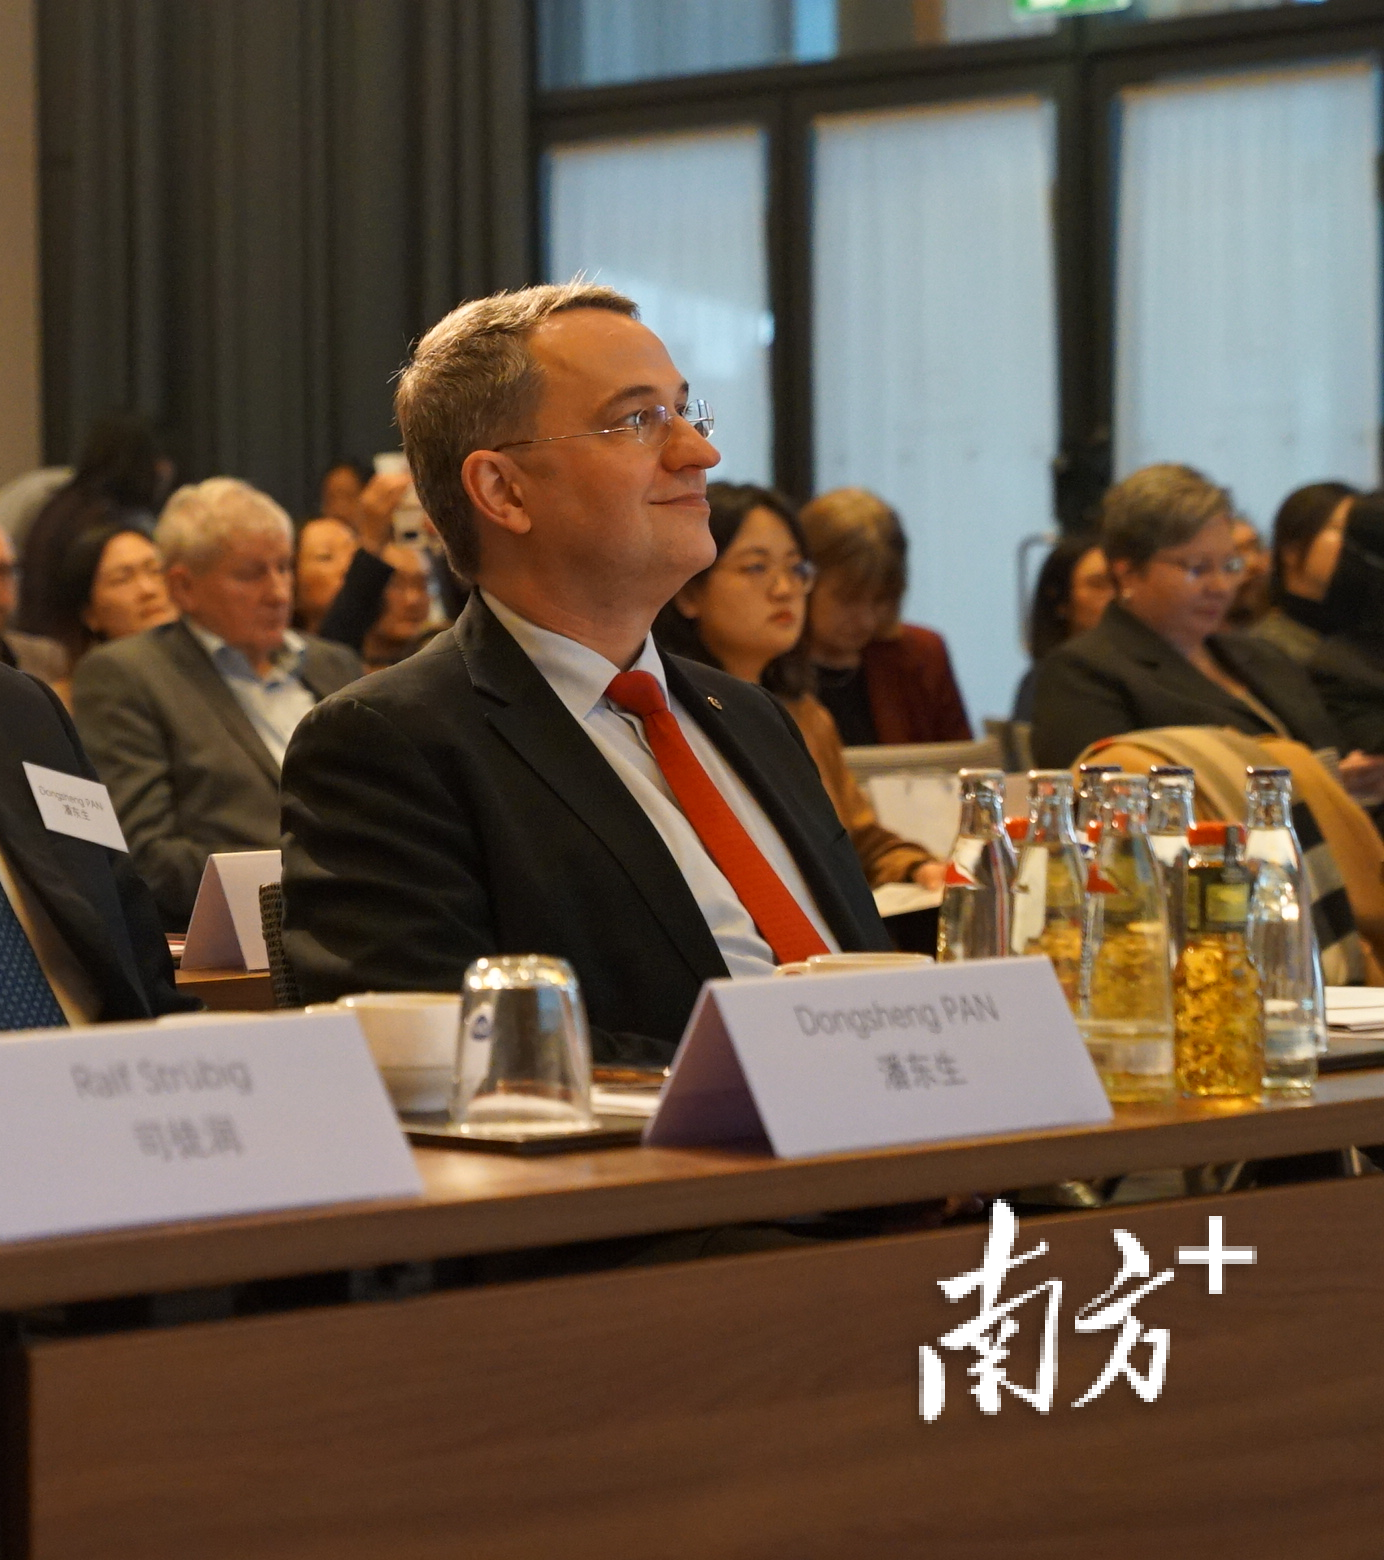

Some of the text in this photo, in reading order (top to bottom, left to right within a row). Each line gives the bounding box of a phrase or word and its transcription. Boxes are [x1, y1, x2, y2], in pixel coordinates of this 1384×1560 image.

[793, 992, 1000, 1040] Dongsheng PAN
[69, 1060, 131, 1098] Ralf
[876, 1050, 968, 1091] 潘东生
